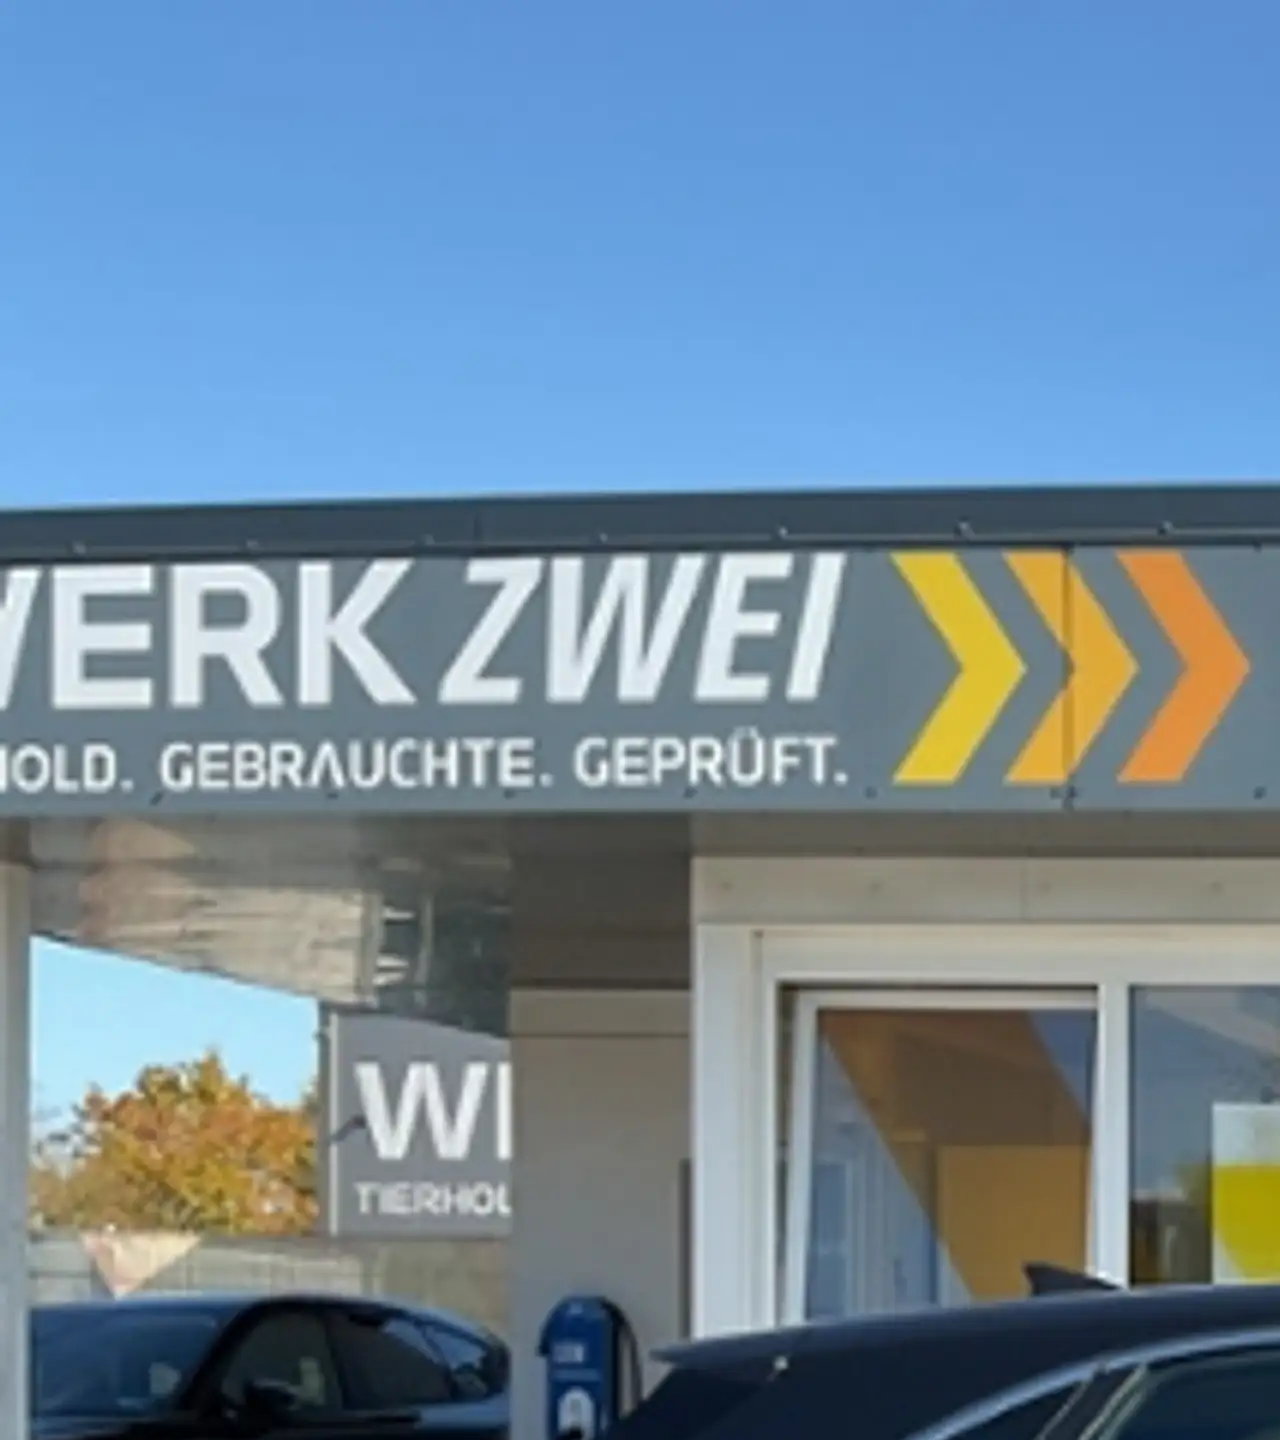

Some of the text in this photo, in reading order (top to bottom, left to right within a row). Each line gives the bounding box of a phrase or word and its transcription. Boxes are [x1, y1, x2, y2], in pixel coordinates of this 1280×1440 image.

[0, 551, 848, 712] ERK ZWEI
[159, 737, 555, 793] GEBRAUCHTE.
[572, 725, 849, 789] GEPRÜFT.
